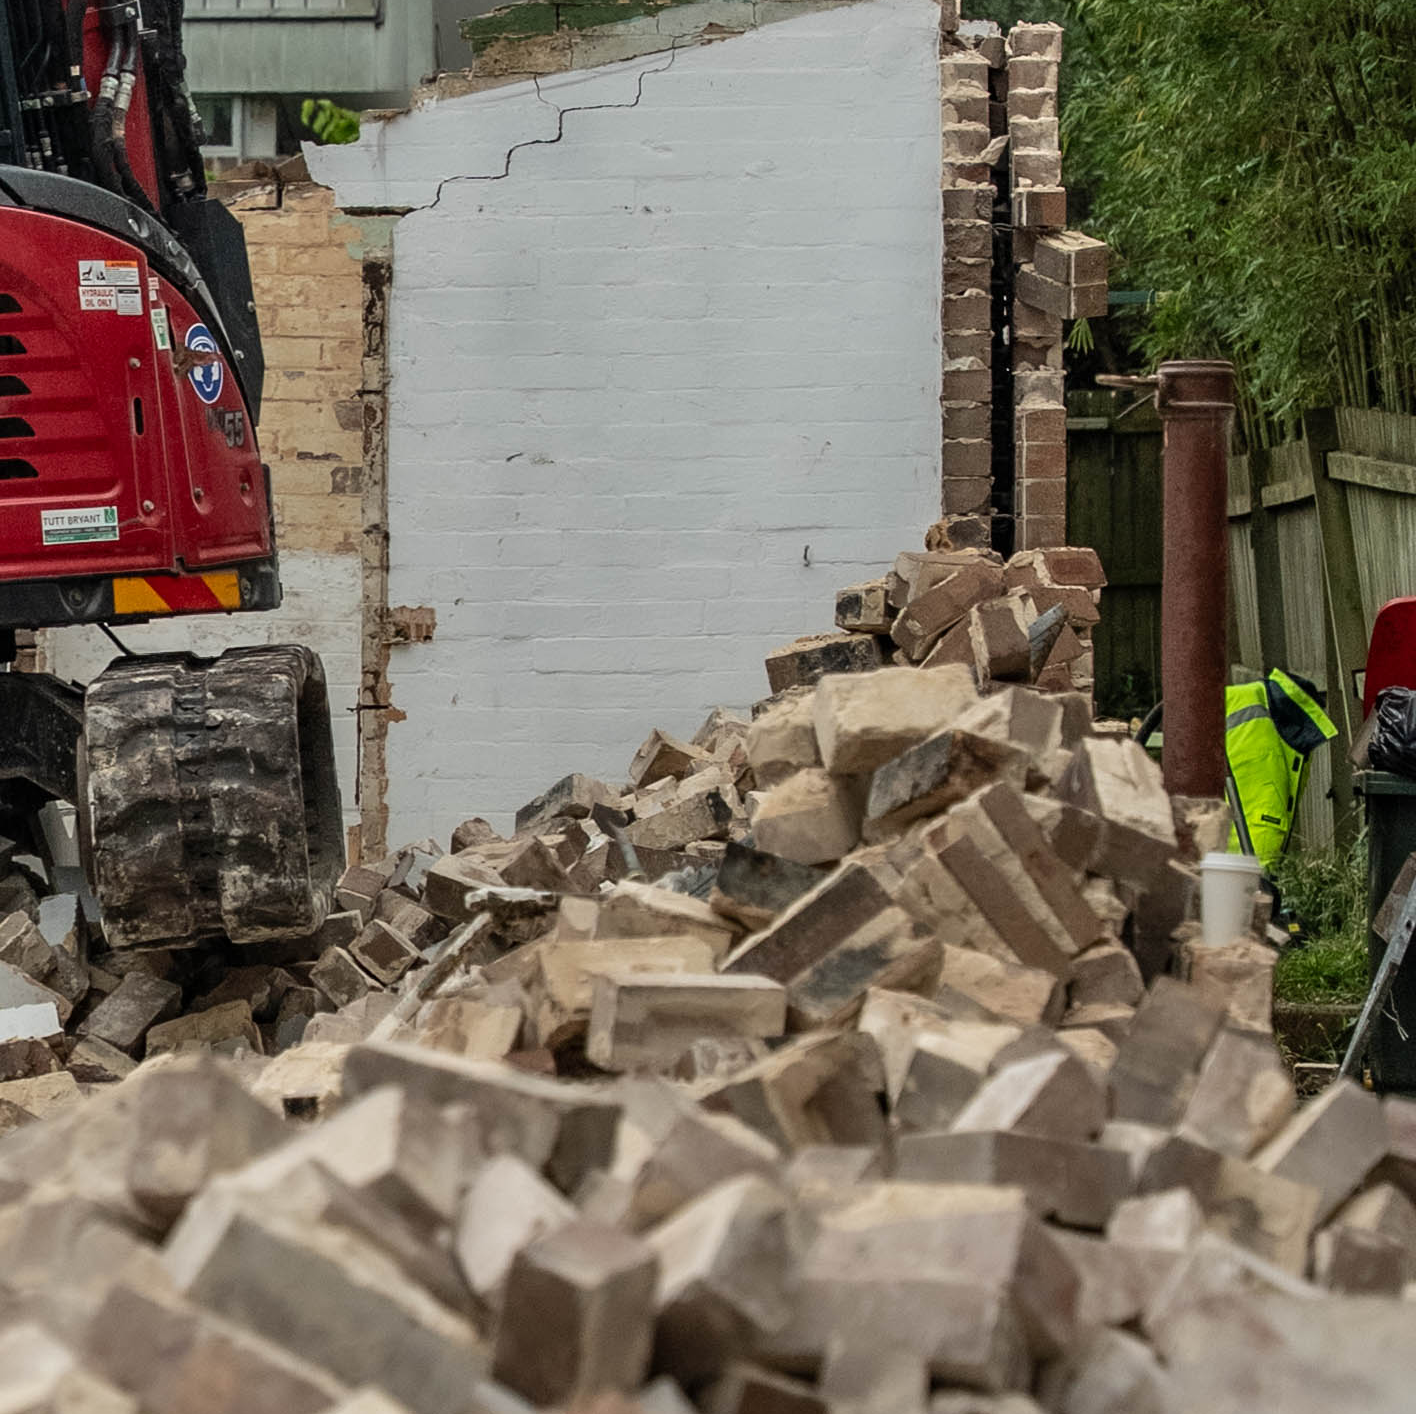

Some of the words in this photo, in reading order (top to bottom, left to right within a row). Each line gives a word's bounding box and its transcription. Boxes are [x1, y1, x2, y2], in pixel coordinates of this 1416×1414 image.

[81, 288, 114, 297] HYDRAULIC
[85, 298, 95, 307] OIL
[97, 298, 112, 307] ONLY
[43, 516, 65, 526] TUTT
[67, 514, 101, 525] BRYANT
